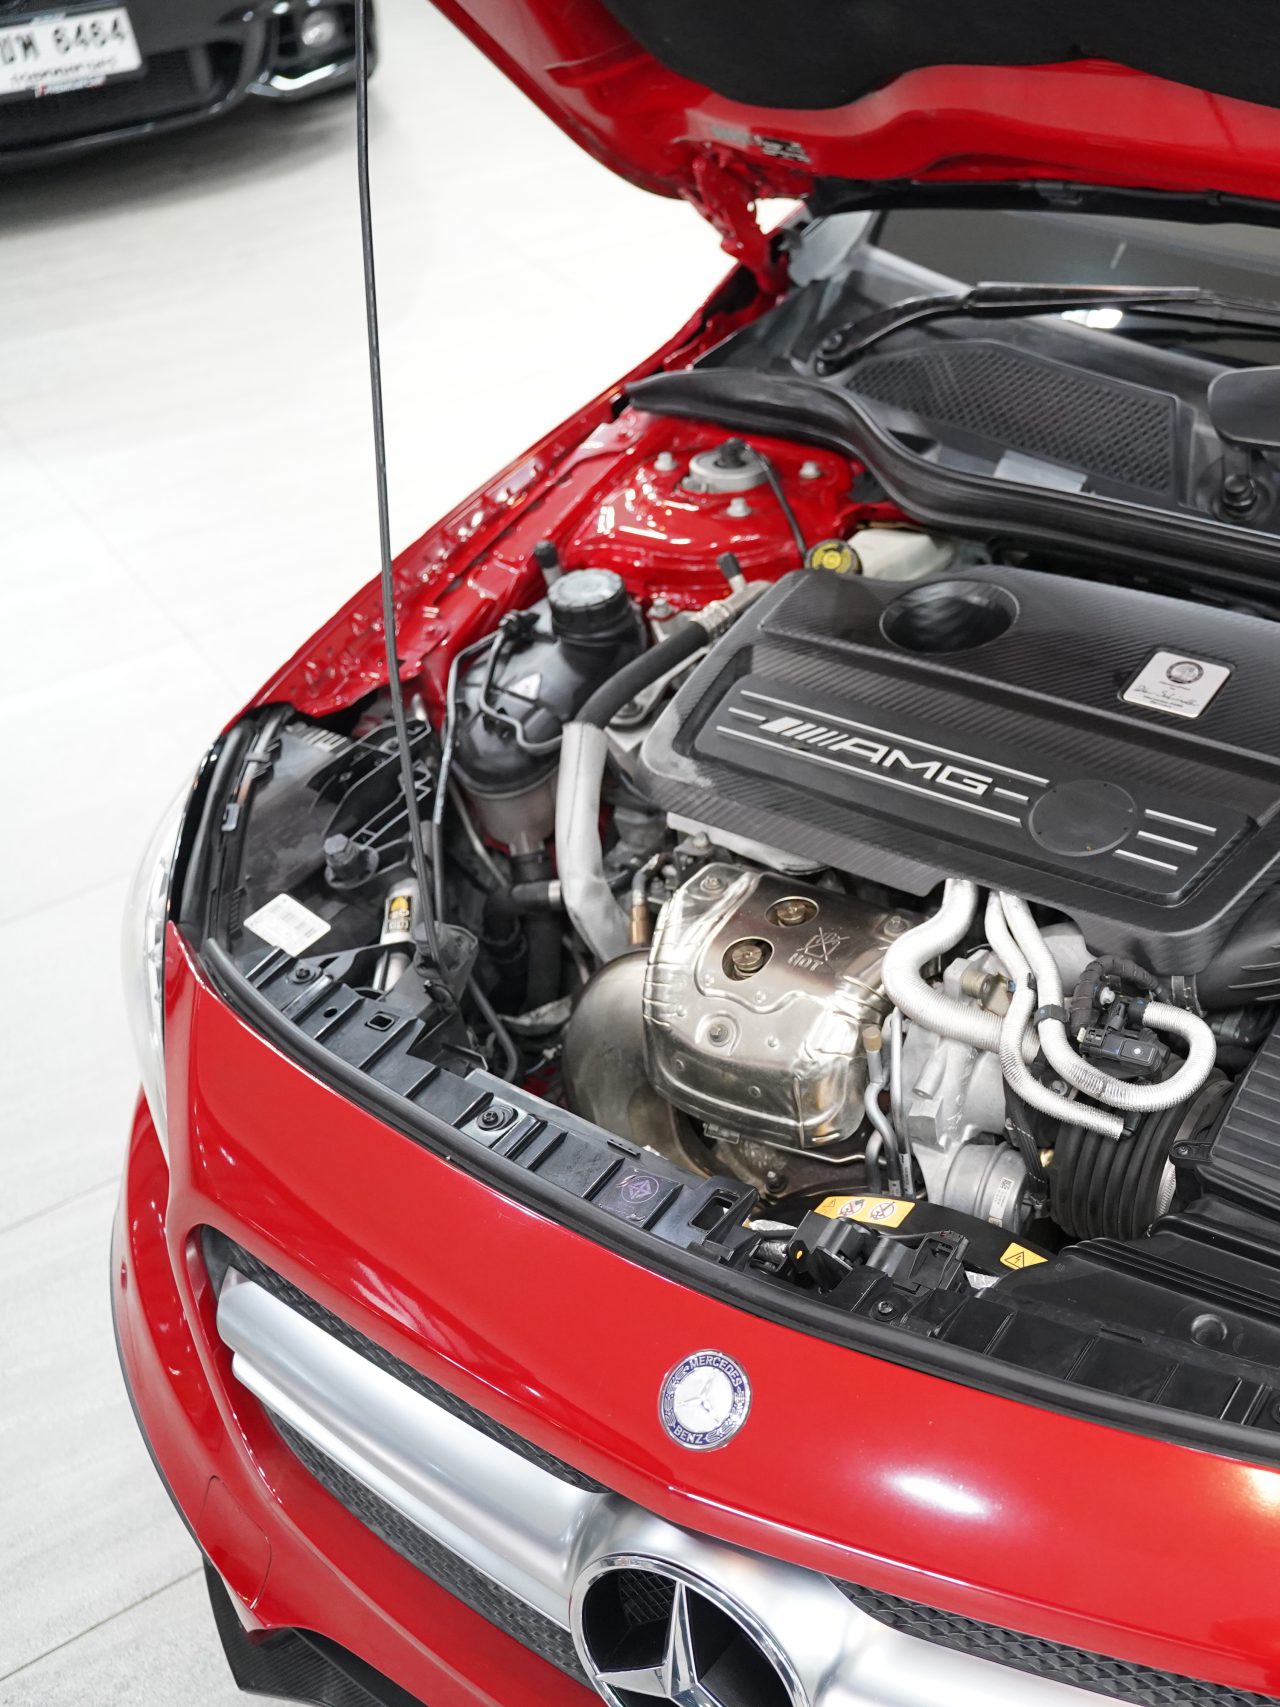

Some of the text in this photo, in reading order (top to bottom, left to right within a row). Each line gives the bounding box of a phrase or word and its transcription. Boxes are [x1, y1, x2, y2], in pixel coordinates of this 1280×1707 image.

[828, 737, 993, 795] AMG
[688, 1355, 743, 1390] MERCEDES
[673, 1425, 704, 1444] BENZ
